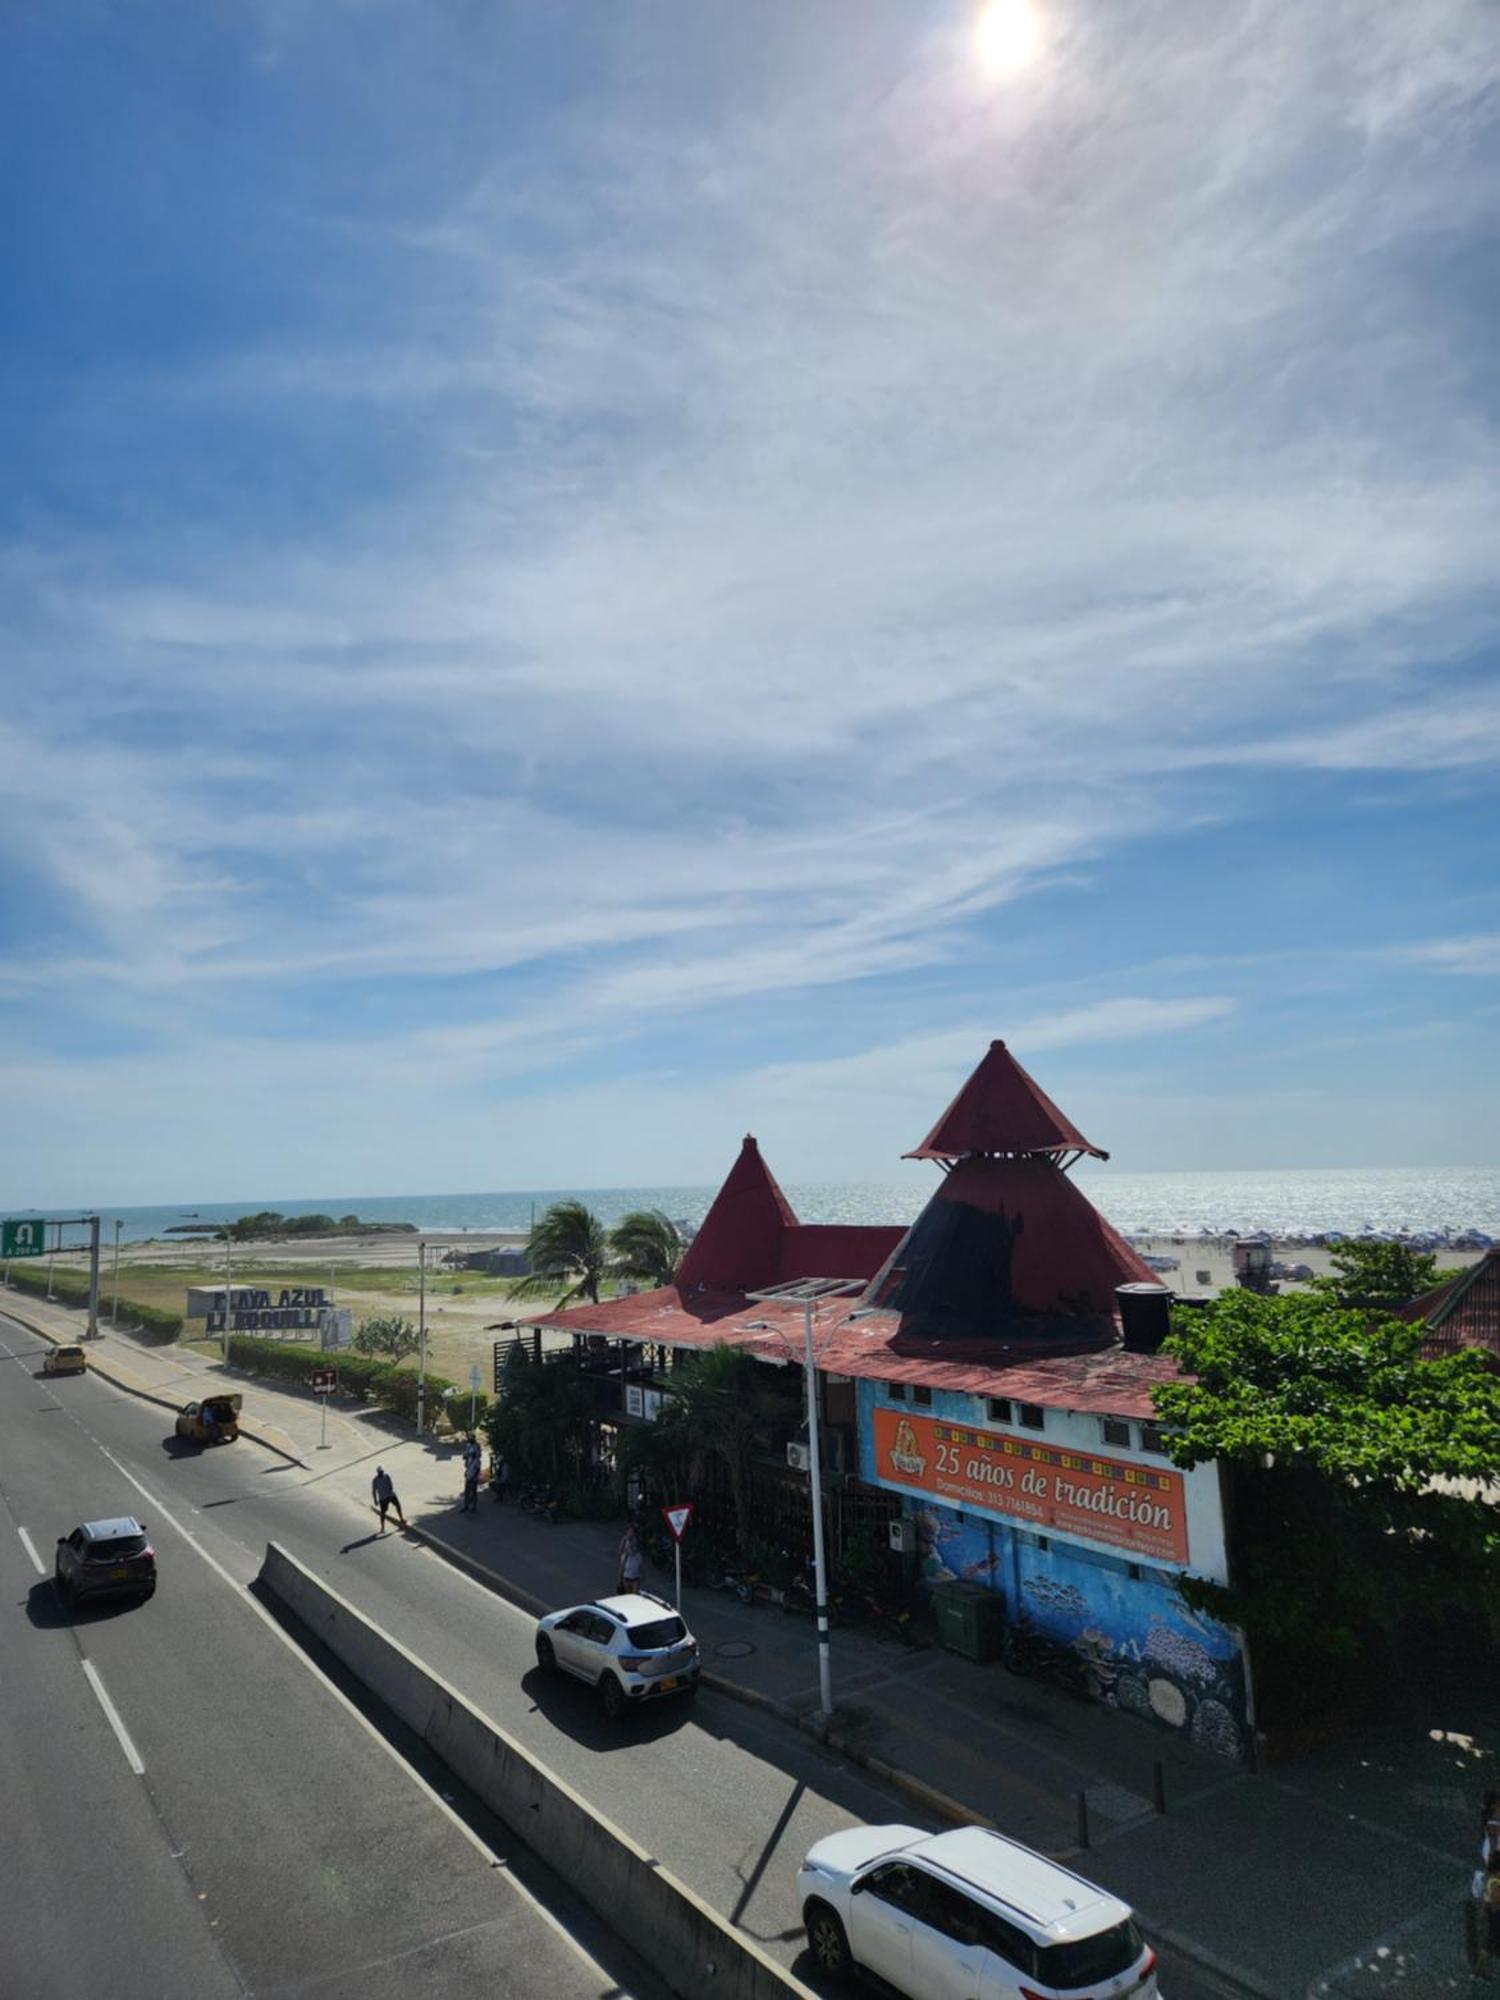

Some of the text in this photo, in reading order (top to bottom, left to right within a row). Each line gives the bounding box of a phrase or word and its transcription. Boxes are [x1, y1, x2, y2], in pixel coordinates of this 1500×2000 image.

[278, 1288, 329, 1307] AZUL
[935, 1443, 961, 1475] 25
[966, 1454, 1014, 1489] años
[1020, 1467, 1047, 1498] de
[1055, 1476, 1173, 1531] tradición
